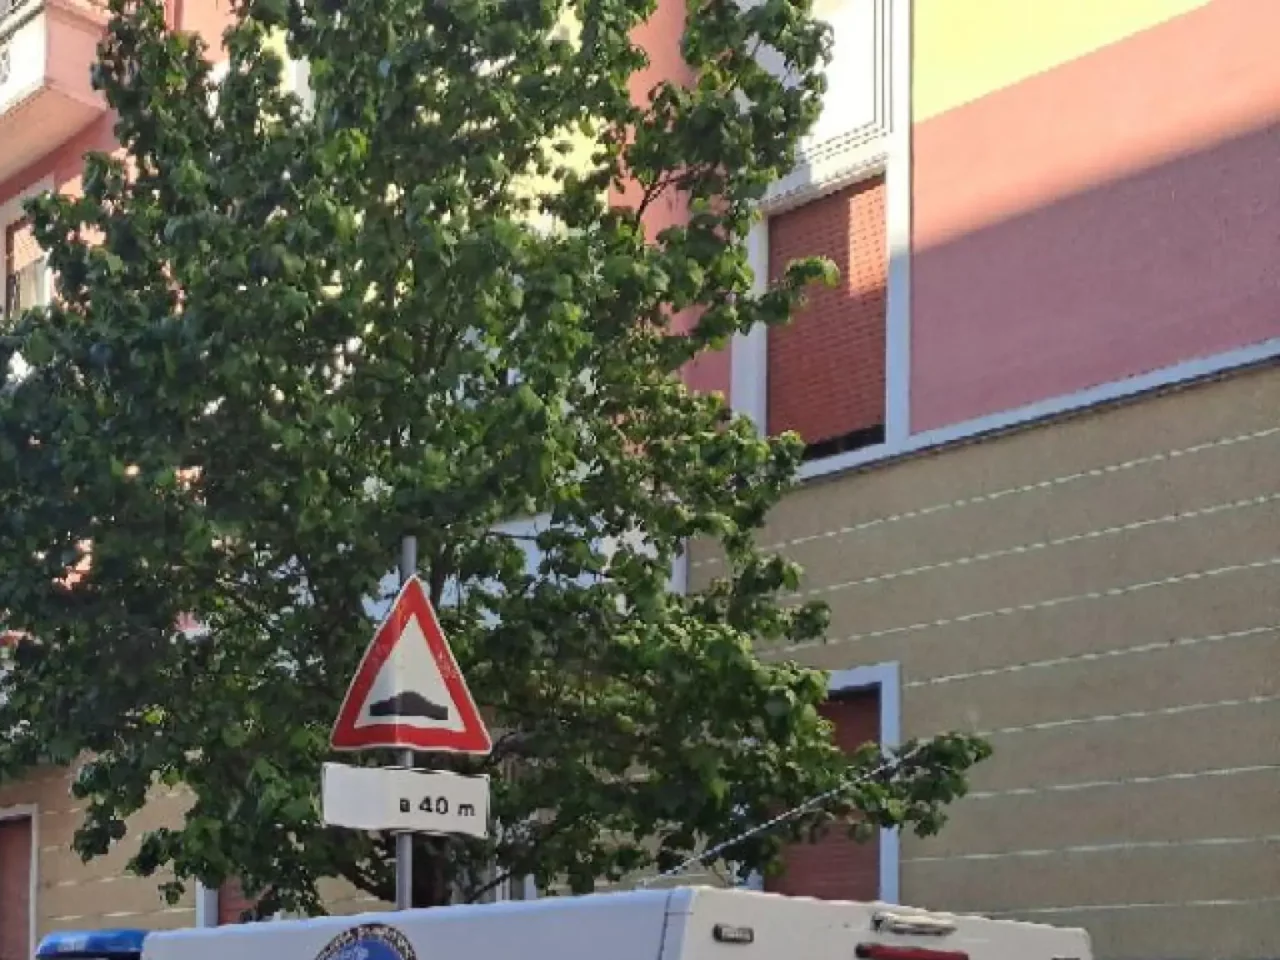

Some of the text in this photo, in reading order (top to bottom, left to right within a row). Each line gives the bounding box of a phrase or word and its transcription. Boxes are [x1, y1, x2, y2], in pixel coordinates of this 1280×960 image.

[400, 796, 475, 816] a 40 m
